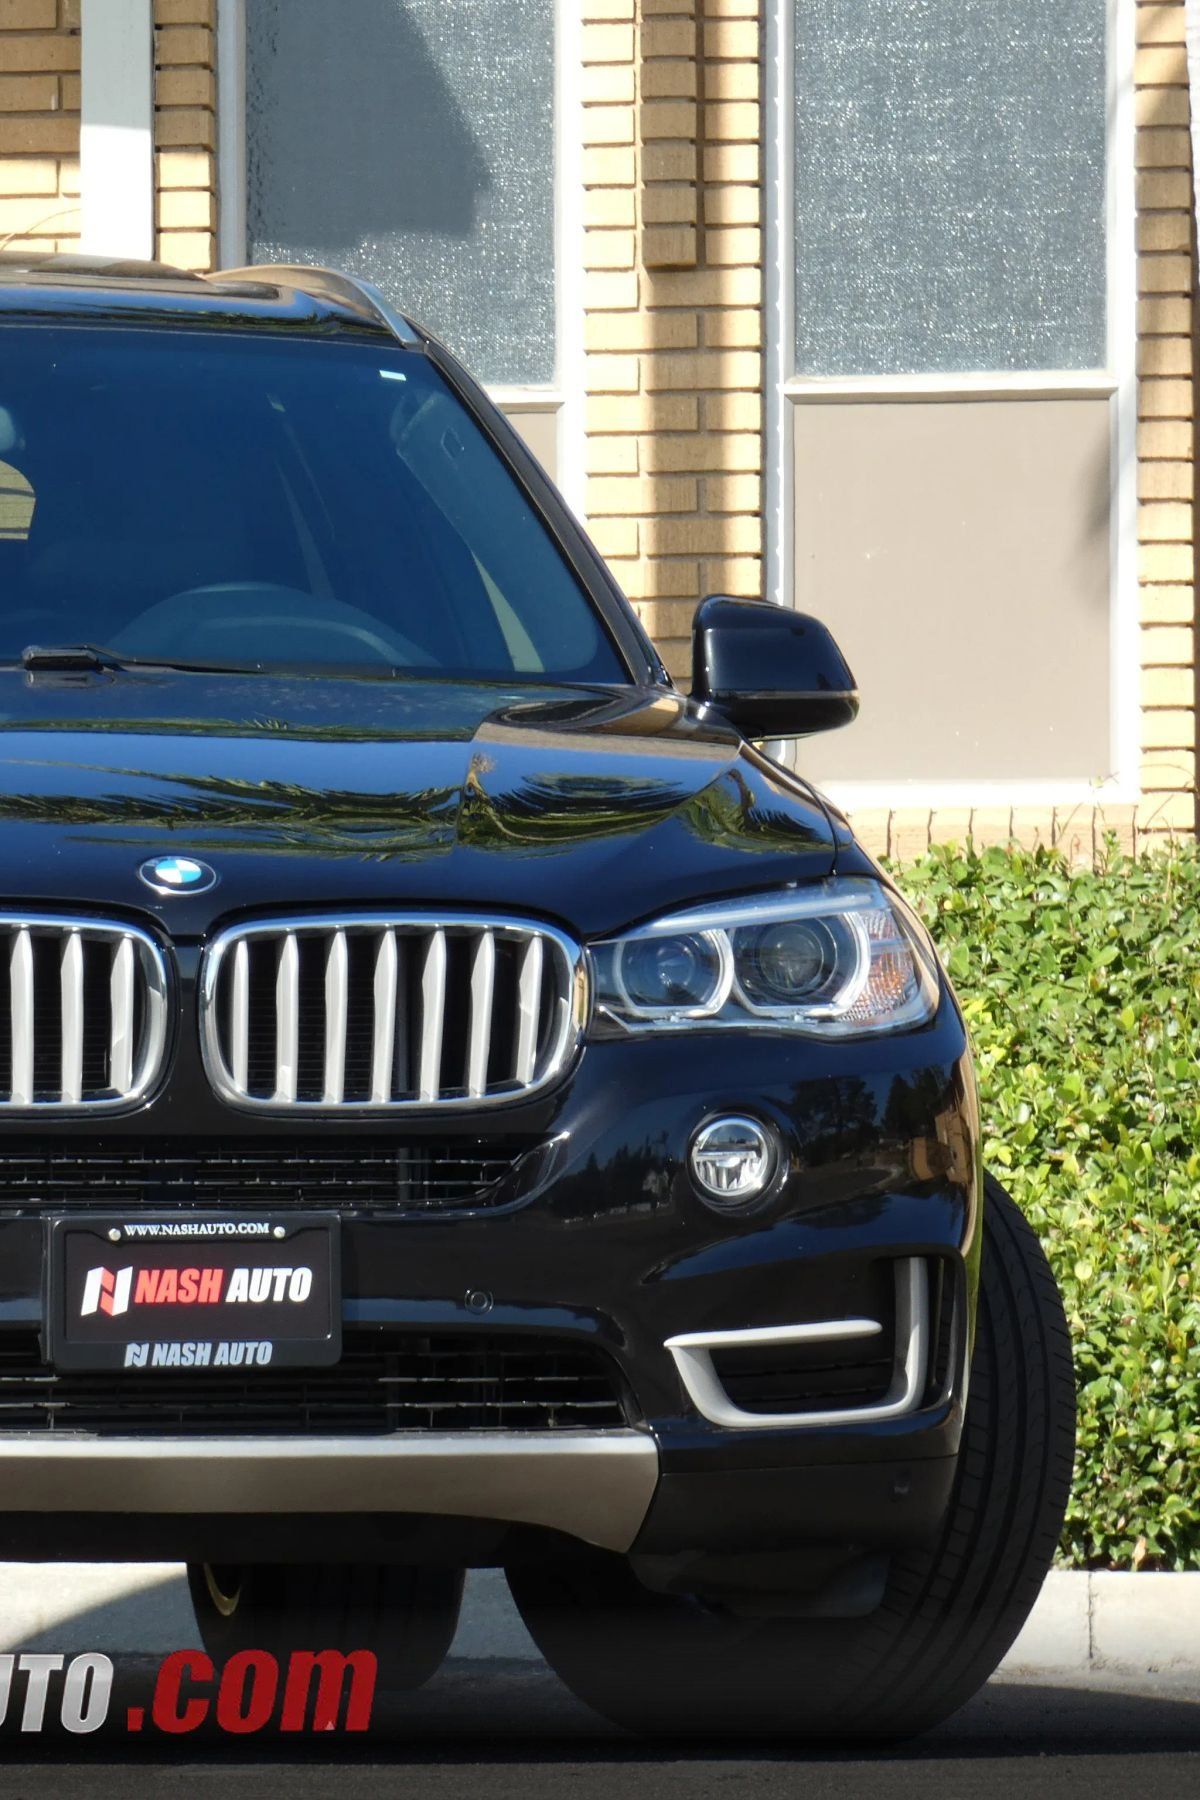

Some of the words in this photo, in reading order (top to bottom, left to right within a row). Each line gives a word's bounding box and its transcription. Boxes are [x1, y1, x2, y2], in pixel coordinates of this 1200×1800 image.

[124, 1222, 270, 1236] WWW.NASHAUTO.COM
[134, 1268, 224, 1304] NASH
[225, 1267, 313, 1303] AUTO
[151, 1342, 211, 1367] NASH
[213, 1341, 273, 1366] AUTO
